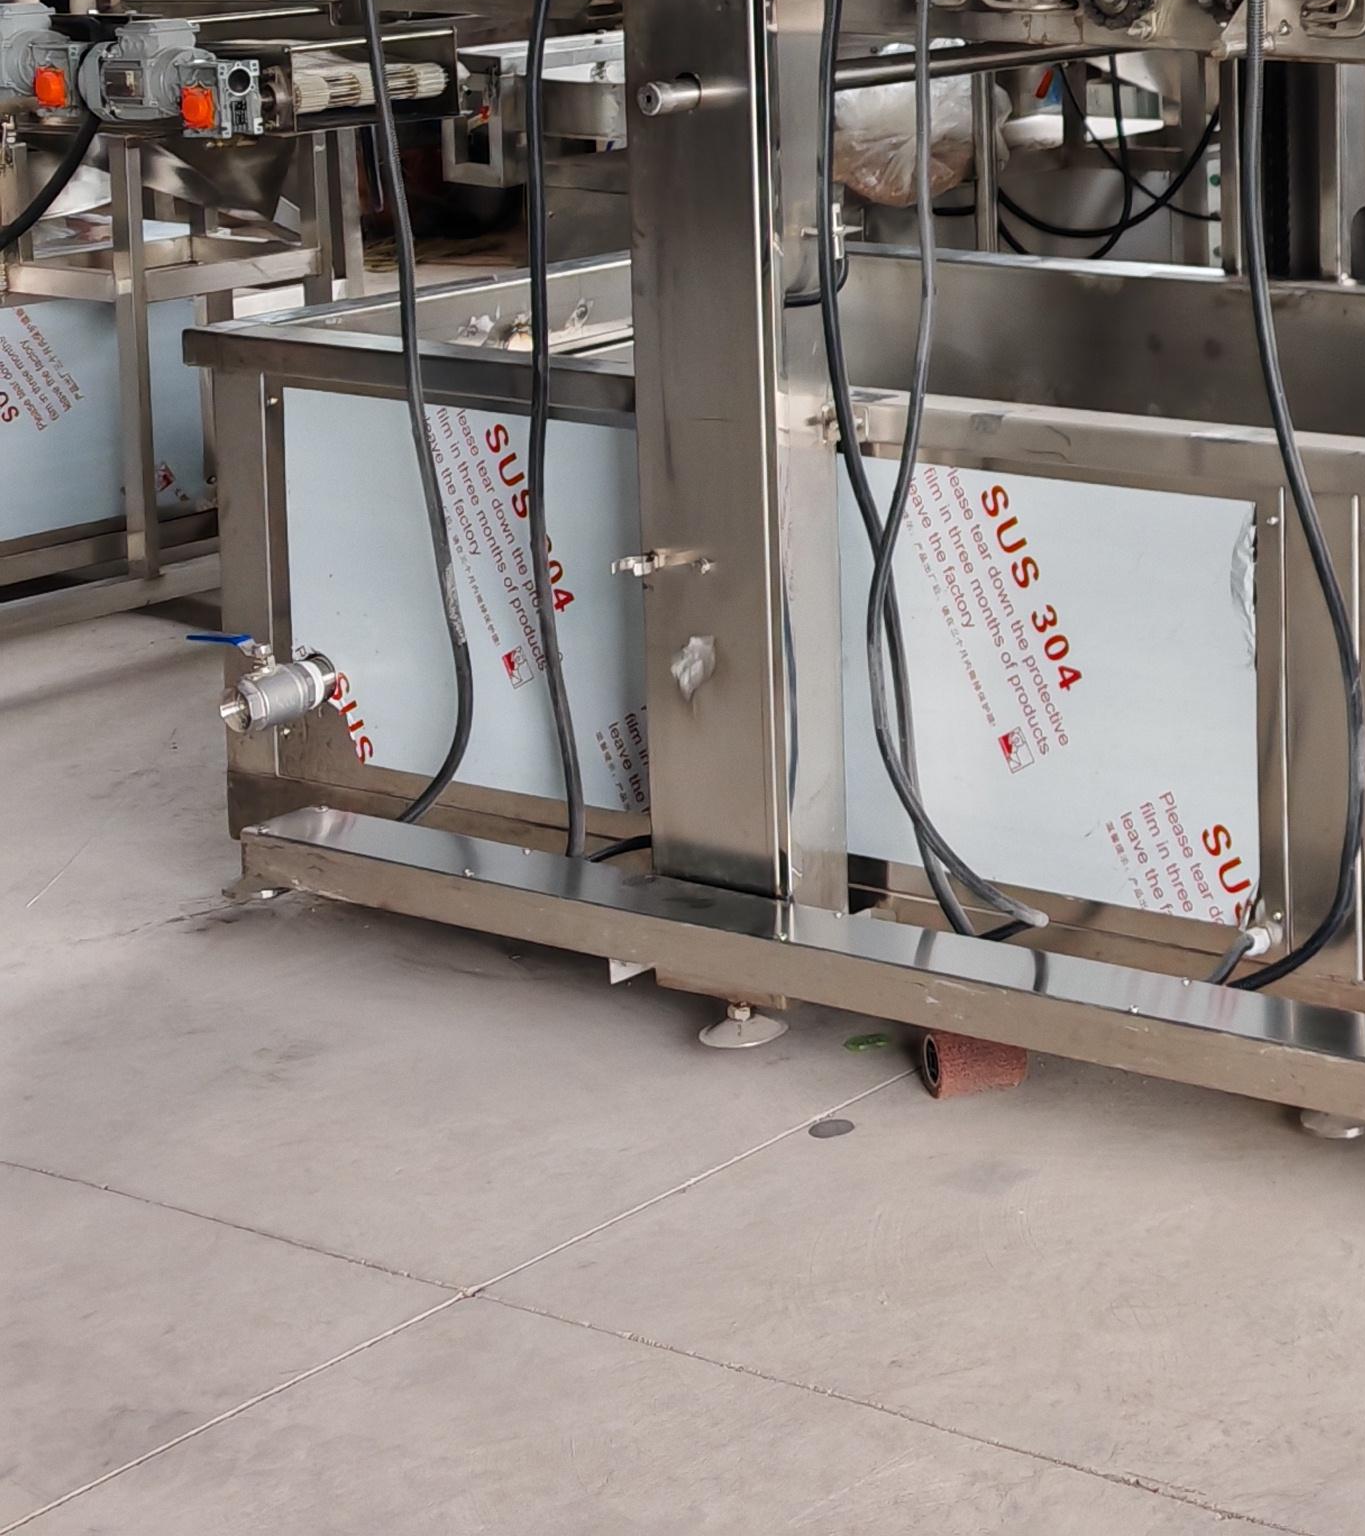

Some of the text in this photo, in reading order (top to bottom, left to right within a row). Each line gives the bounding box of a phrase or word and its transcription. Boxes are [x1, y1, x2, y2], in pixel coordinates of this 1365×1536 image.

[436, 407, 454, 440] film
[450, 441, 462, 460] in
[441, 466, 456, 496] the
[453, 498, 482, 557] factory
[456, 408, 529, 576] lease tear down the
[457, 461, 480, 507] three
[476, 509, 507, 574] months
[503, 575, 518, 595] of
[927, 531, 946, 564] the
[943, 565, 975, 629] factory
[923, 467, 1051, 756] film in three months of products
[946, 466, 1070, 747] lease tear down the protective
[980, 484, 1083, 692] SUS 304
[510, 596, 548, 672] products
[608, 721, 633, 770] leave
[628, 773, 645, 803] the
[1120, 811, 1164, 900] leave the
[1139, 801, 1161, 838] film
[1156, 840, 1171, 860] in
[1166, 862, 1194, 913] three
[1159, 791, 1194, 859] Please
[1189, 862, 1214, 901] tear
